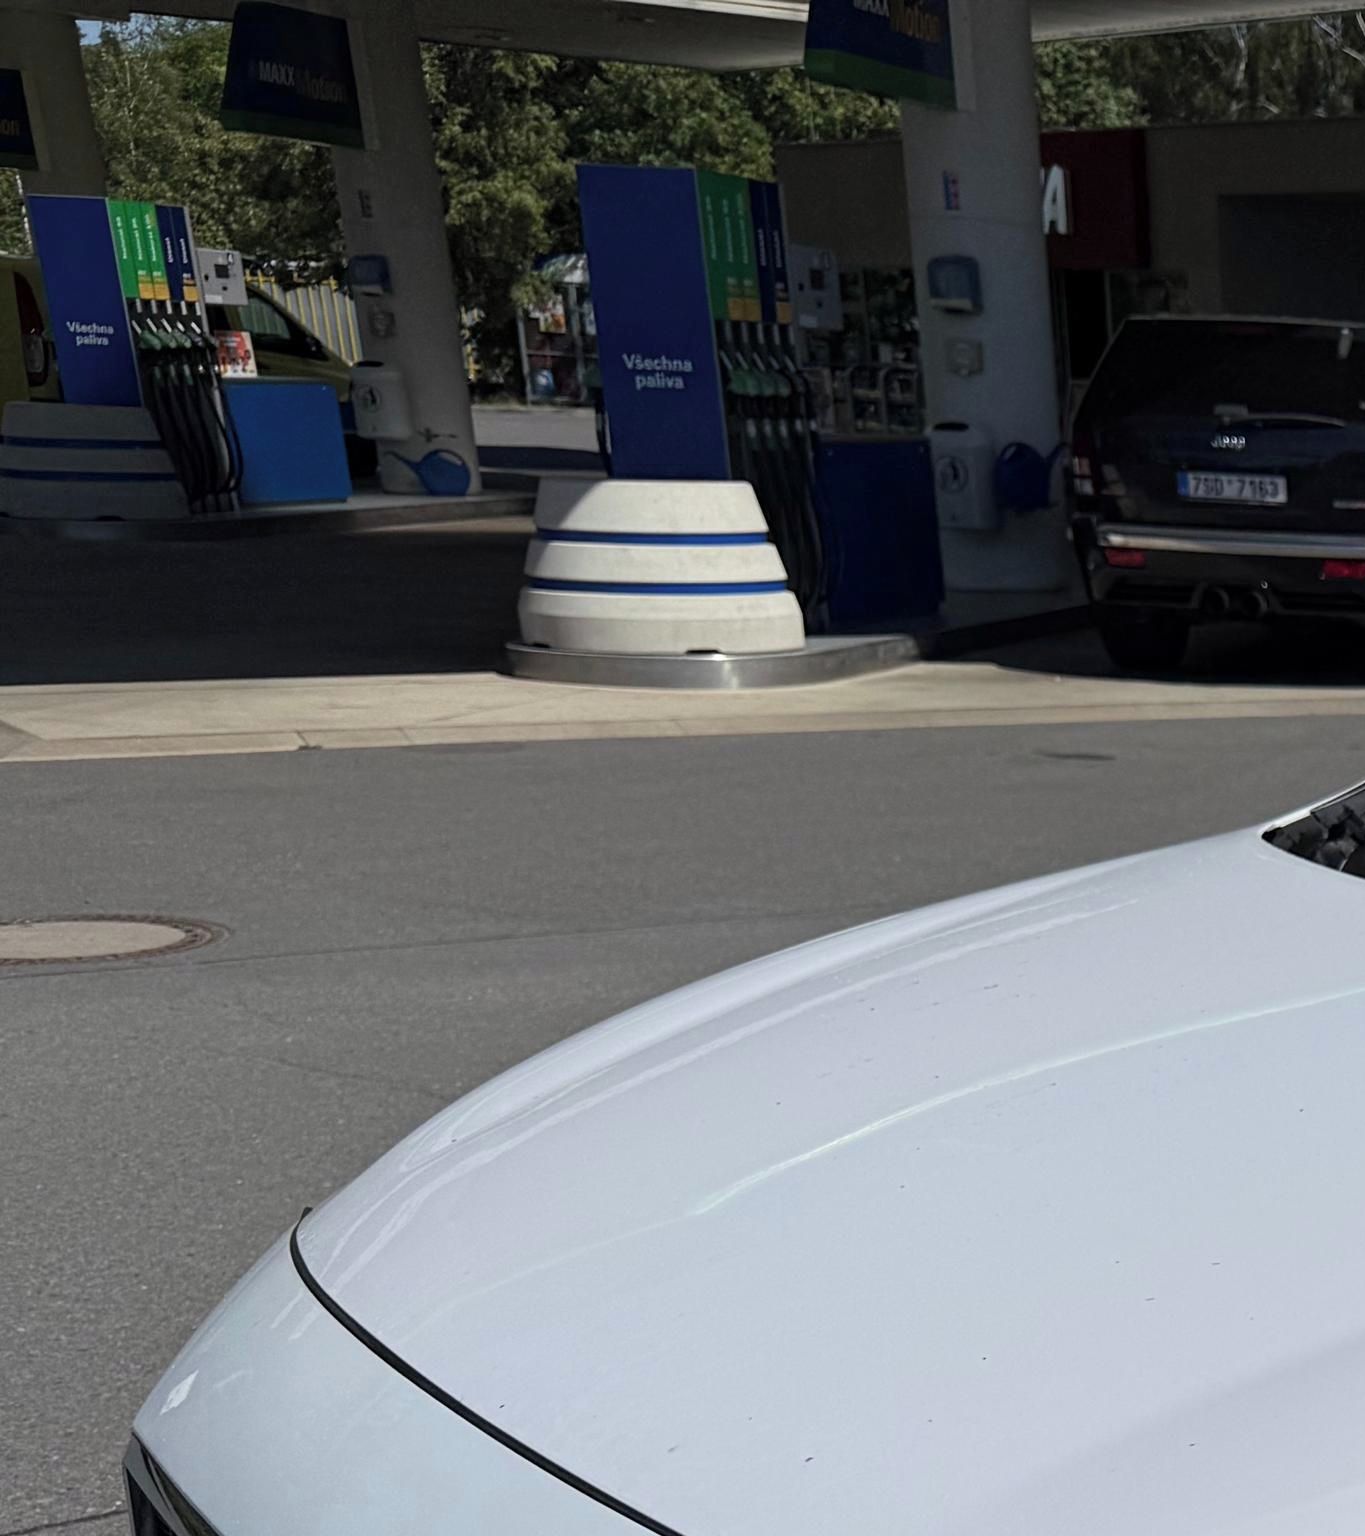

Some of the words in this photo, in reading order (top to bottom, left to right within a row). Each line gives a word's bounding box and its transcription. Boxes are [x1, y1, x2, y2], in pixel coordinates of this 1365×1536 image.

[257, 60, 296, 87] MAXX
[621, 352, 694, 373] Všechna
[634, 371, 686, 391] paliva
